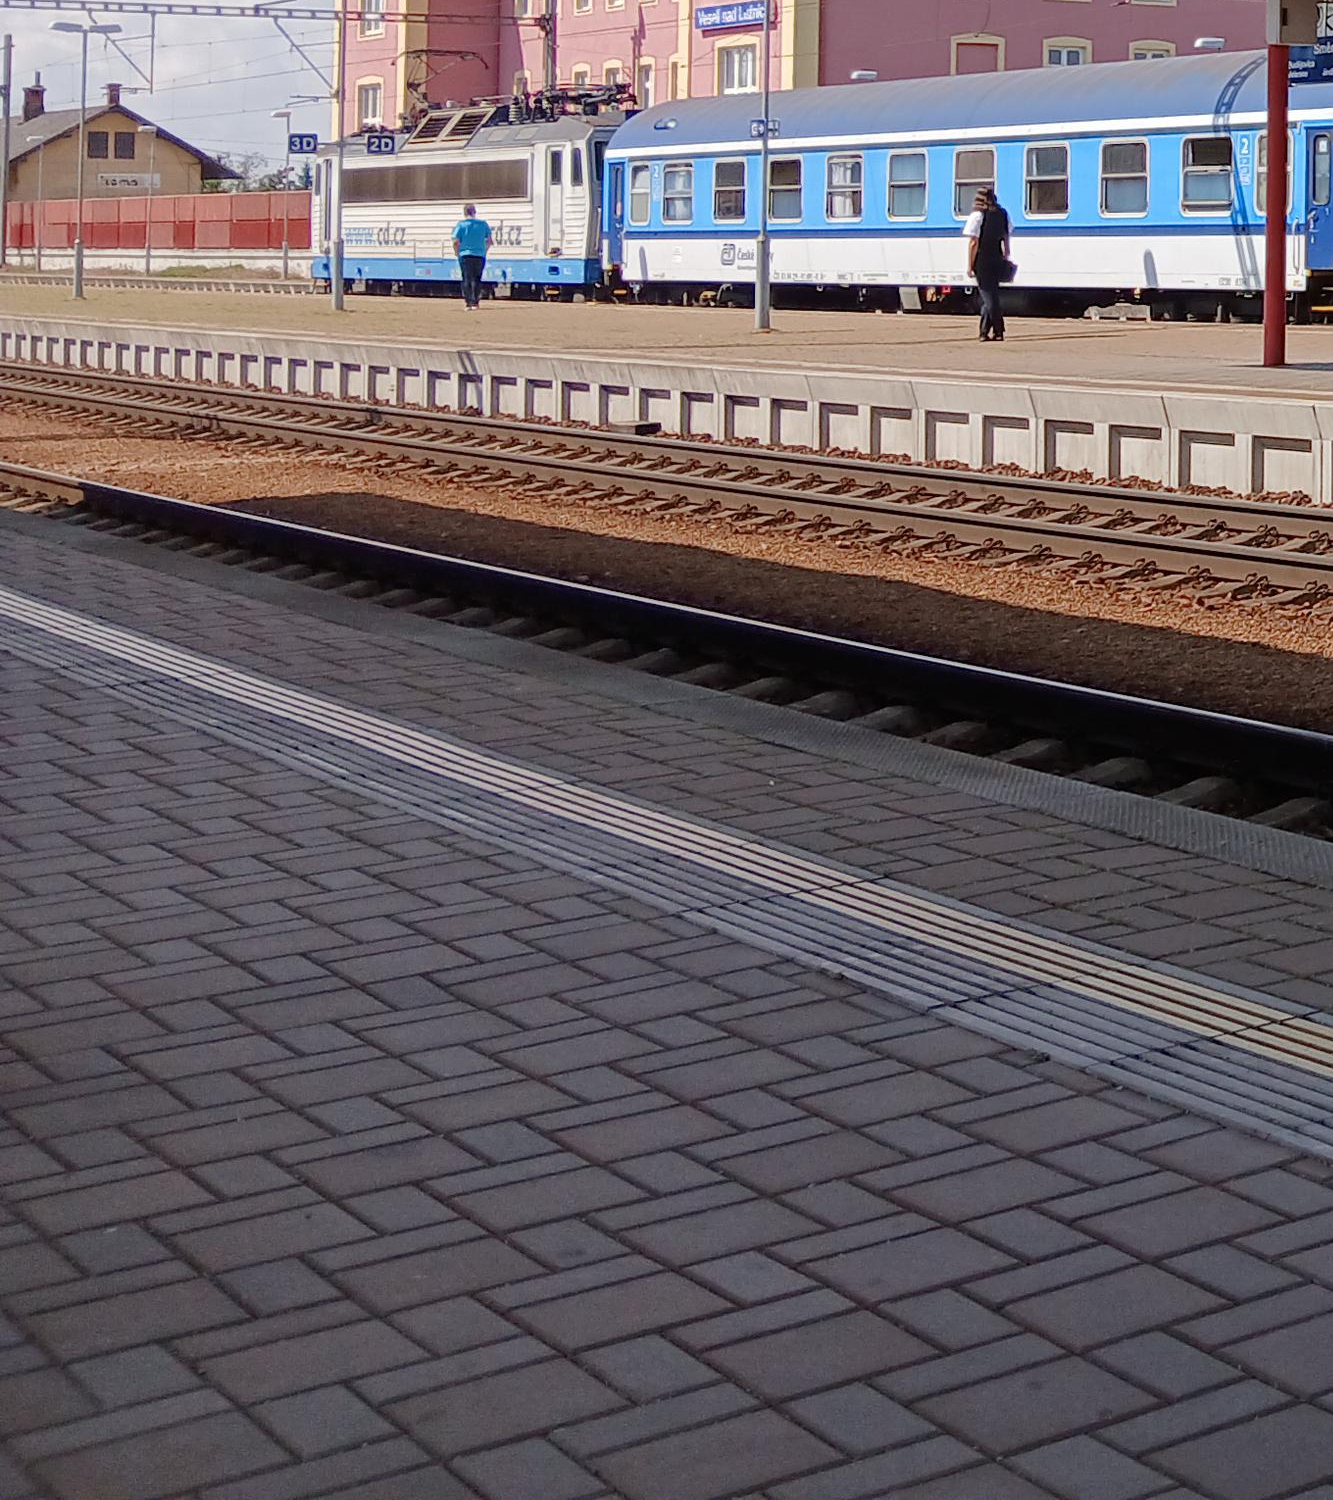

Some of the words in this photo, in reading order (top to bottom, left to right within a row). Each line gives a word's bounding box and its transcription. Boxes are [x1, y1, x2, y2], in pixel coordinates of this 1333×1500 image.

[739, 3, 766, 21] Lužnic
[291, 136, 315, 151] 3D
[370, 137, 393, 152] 2D
[1241, 137, 1249, 154] 2
